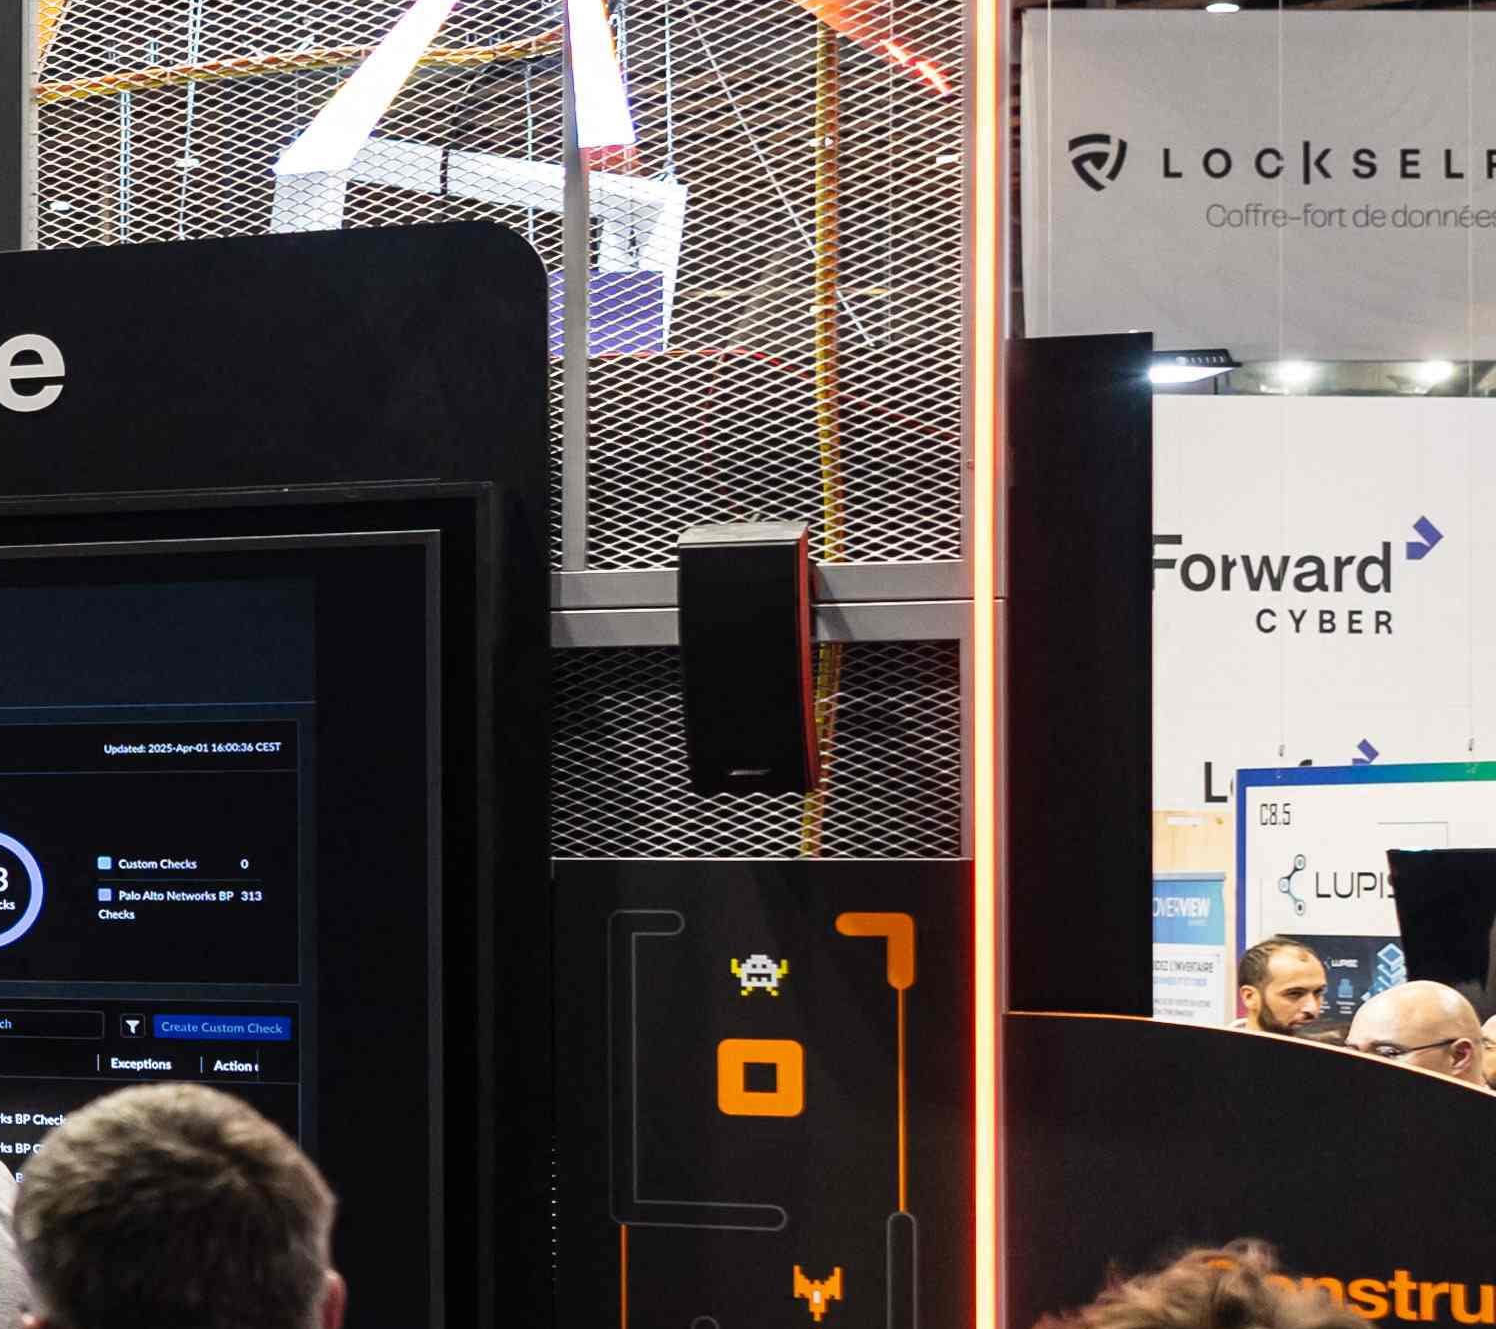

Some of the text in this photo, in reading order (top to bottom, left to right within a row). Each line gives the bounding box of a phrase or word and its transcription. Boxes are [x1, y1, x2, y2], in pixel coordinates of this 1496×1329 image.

[1205, 202, 1348, 229] Coffre-fort
[1351, 203, 1389, 229] de
[1151, 532, 1392, 596] Forward
[1255, 608, 1393, 635] CYBER
[103, 741, 282, 756] Updated: 2025-Apr-01 16:00:36 CEST
[1260, 802, 1291, 826] C8.5
[118, 858, 249, 870] Custom Checks 0
[118, 889, 263, 902] Palo Alto Networks BP 313
[97, 908, 136, 920] Checks
[159, 1021, 283, 1034] Create Custom Check
[110, 1057, 172, 1072] Exceptions
[213, 1059, 253, 1072] Action
